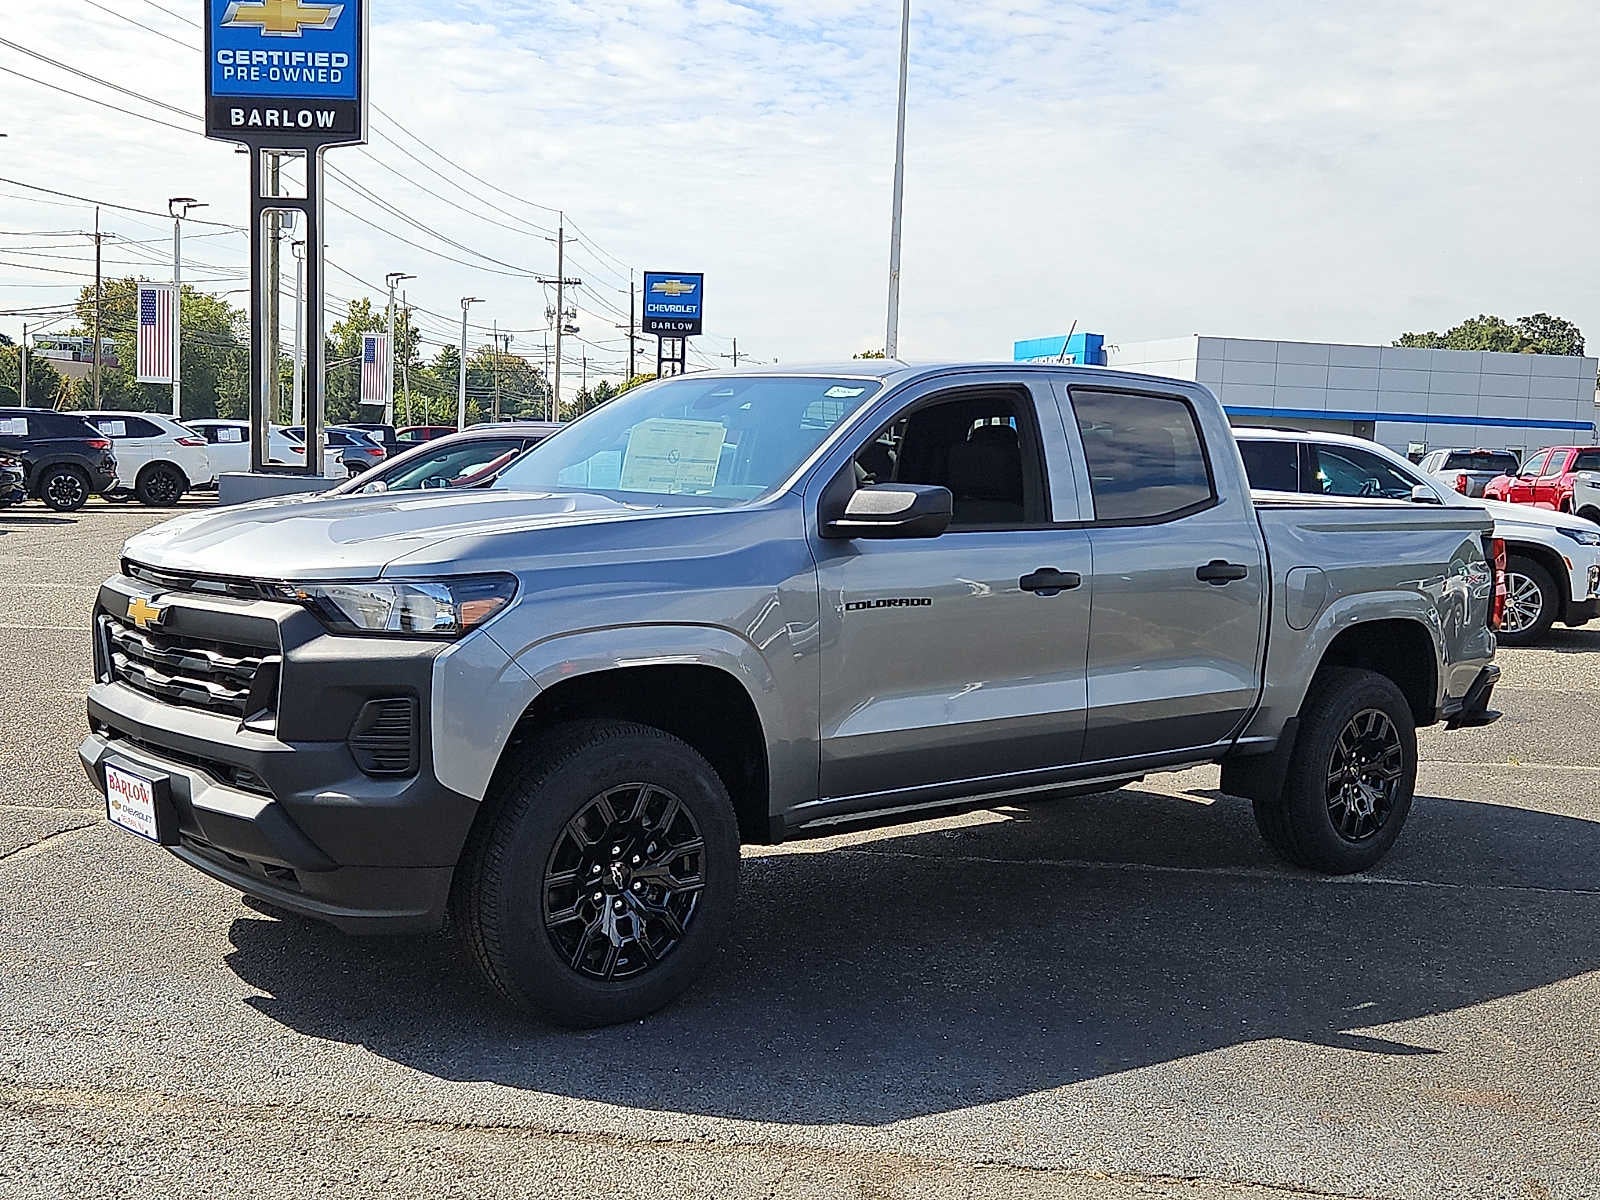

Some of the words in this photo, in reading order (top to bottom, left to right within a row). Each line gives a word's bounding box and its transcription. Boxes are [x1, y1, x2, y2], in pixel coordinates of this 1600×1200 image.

[217, 50, 349, 68] CERTIFIED
[223, 66, 342, 83] PRE-OWNED
[230, 108, 336, 128] BARLOW
[647, 304, 697, 313] CHEVROLET
[651, 321, 693, 330] BARLOW
[845, 598, 932, 611] COLORADO
[108, 774, 150, 805] BARLOW
